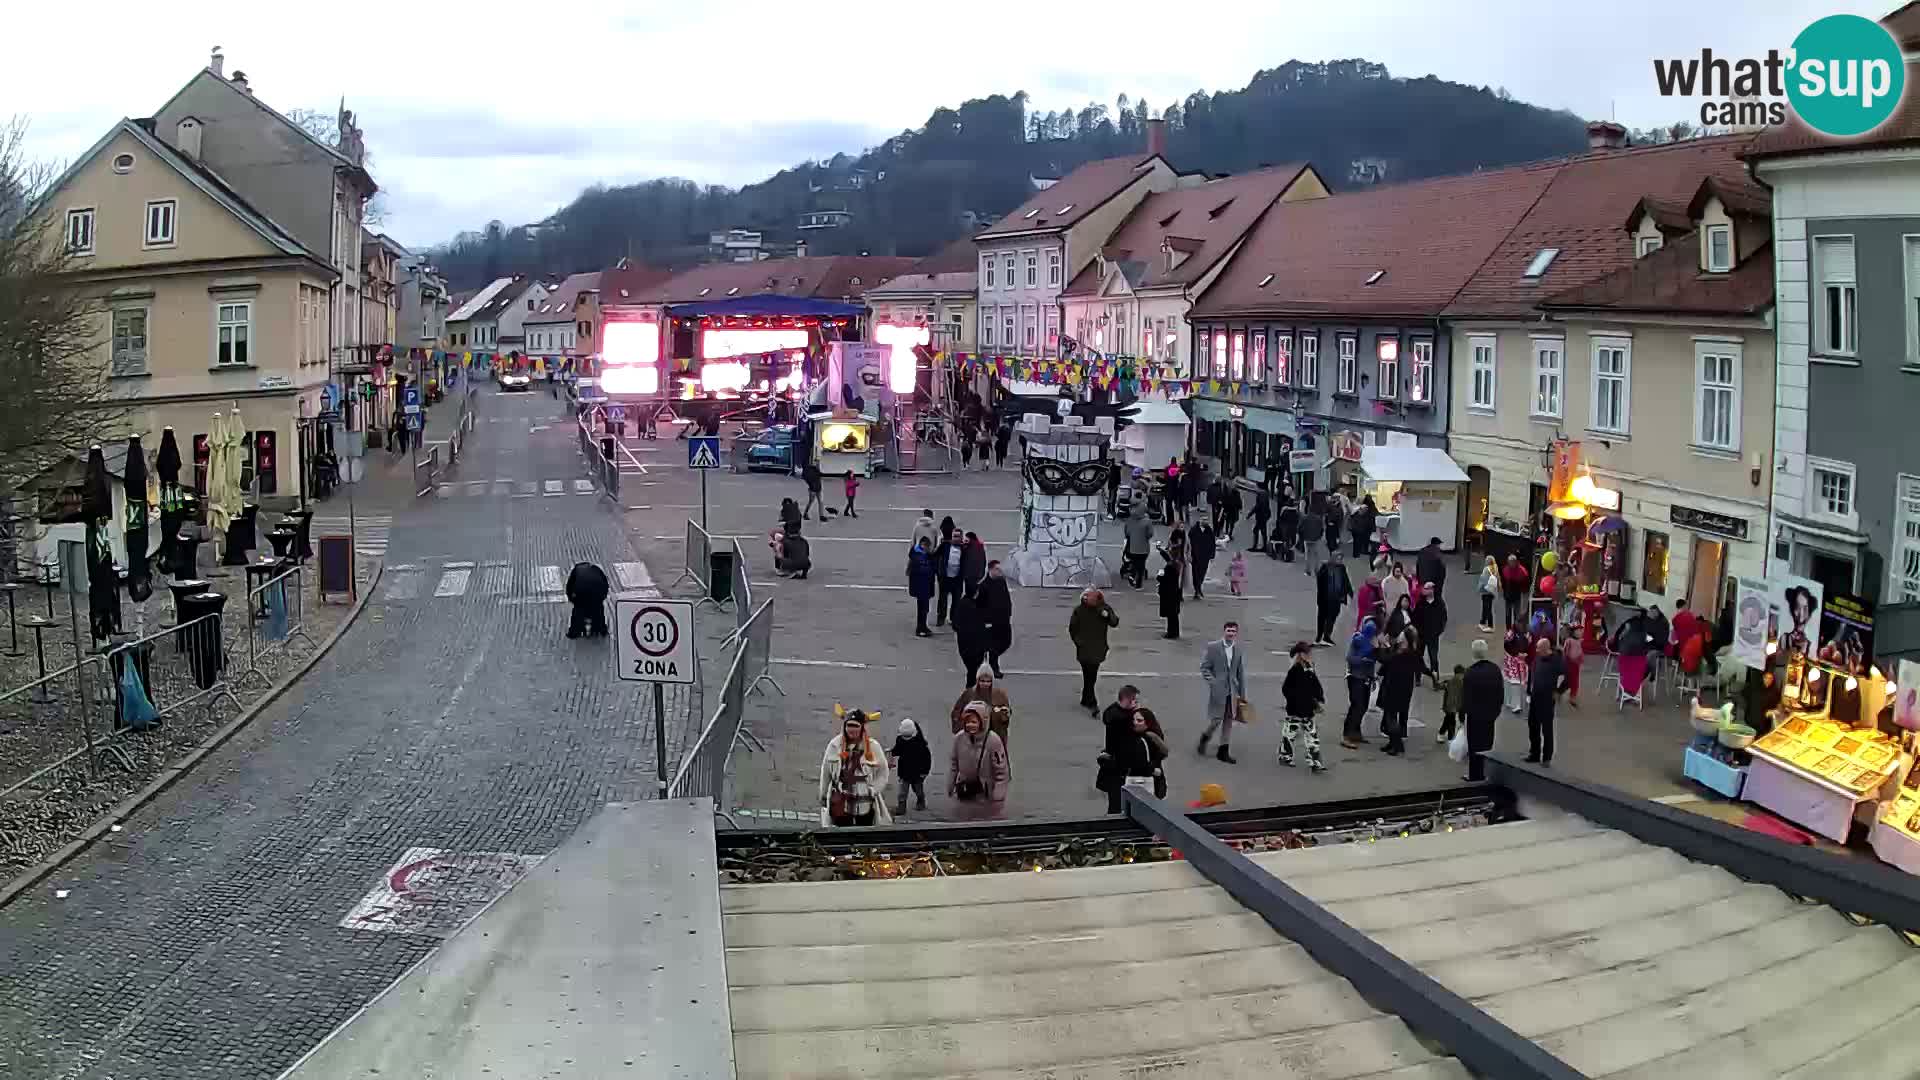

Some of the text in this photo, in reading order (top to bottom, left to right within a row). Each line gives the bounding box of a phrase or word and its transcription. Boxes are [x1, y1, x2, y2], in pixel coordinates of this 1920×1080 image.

[407, 391, 416, 403] P
[1048, 516, 1087, 545] 200
[643, 622, 668, 643] 30
[633, 659, 679, 677] ZONA
